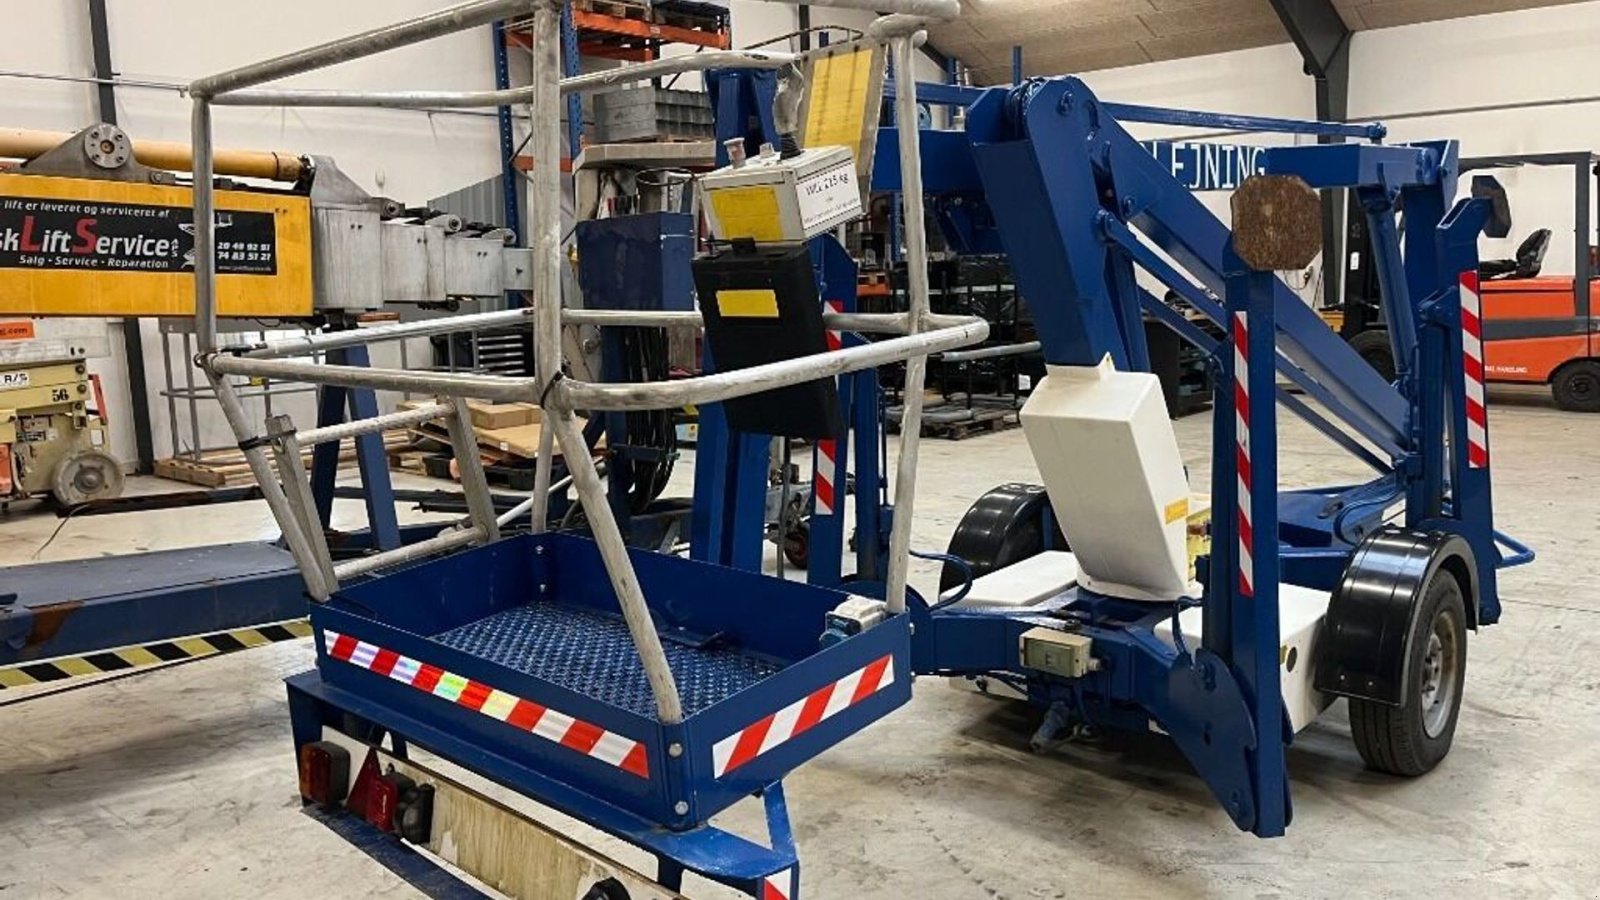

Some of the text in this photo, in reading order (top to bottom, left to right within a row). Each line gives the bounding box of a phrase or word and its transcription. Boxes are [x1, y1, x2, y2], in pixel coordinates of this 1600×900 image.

[4, 200, 170, 218] lift er leveret og serviceret af
[19, 255, 169, 269] Salg Service Reparation
[51, 388, 70, 402] 56
